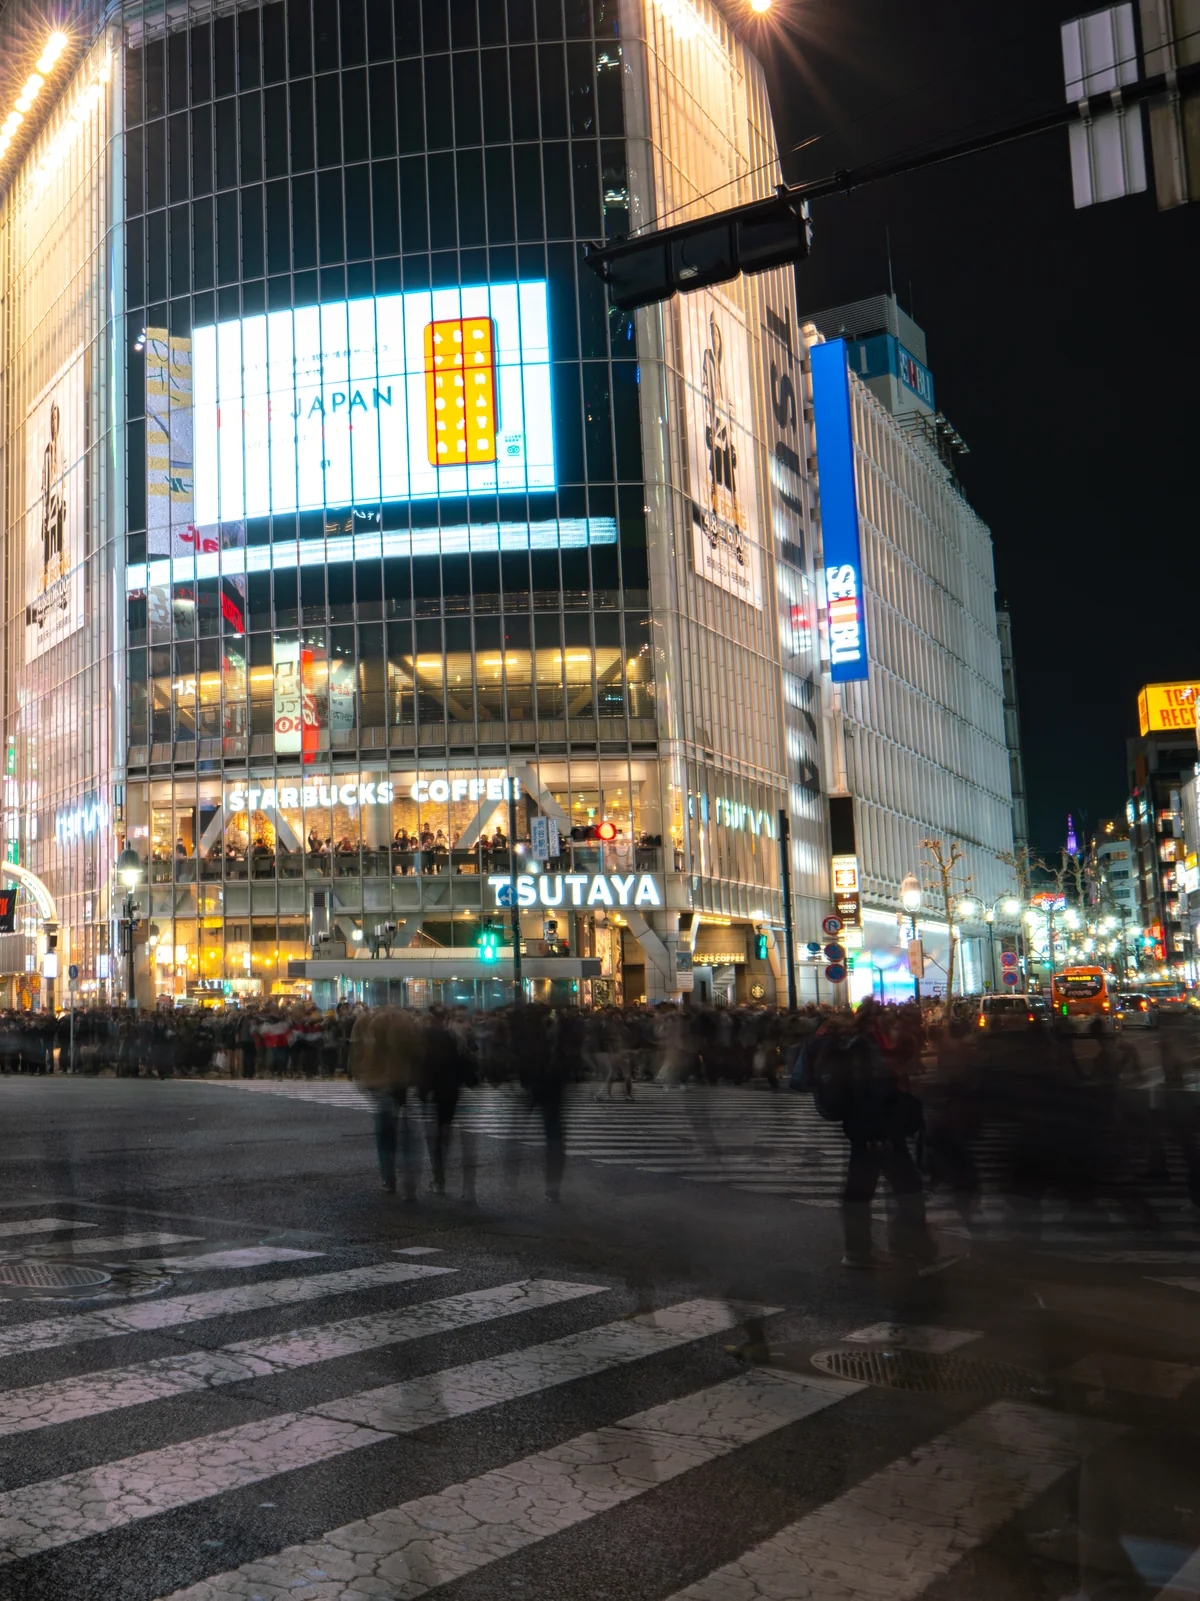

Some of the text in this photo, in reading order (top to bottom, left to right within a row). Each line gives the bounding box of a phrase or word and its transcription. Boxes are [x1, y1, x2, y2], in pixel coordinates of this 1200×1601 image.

[290, 385, 392, 419] JAPAN
[229, 777, 520, 812] STARBUCKS COFFEE
[487, 874, 661, 907] TSUTAYA
[715, 952, 745, 962] COFFEE
